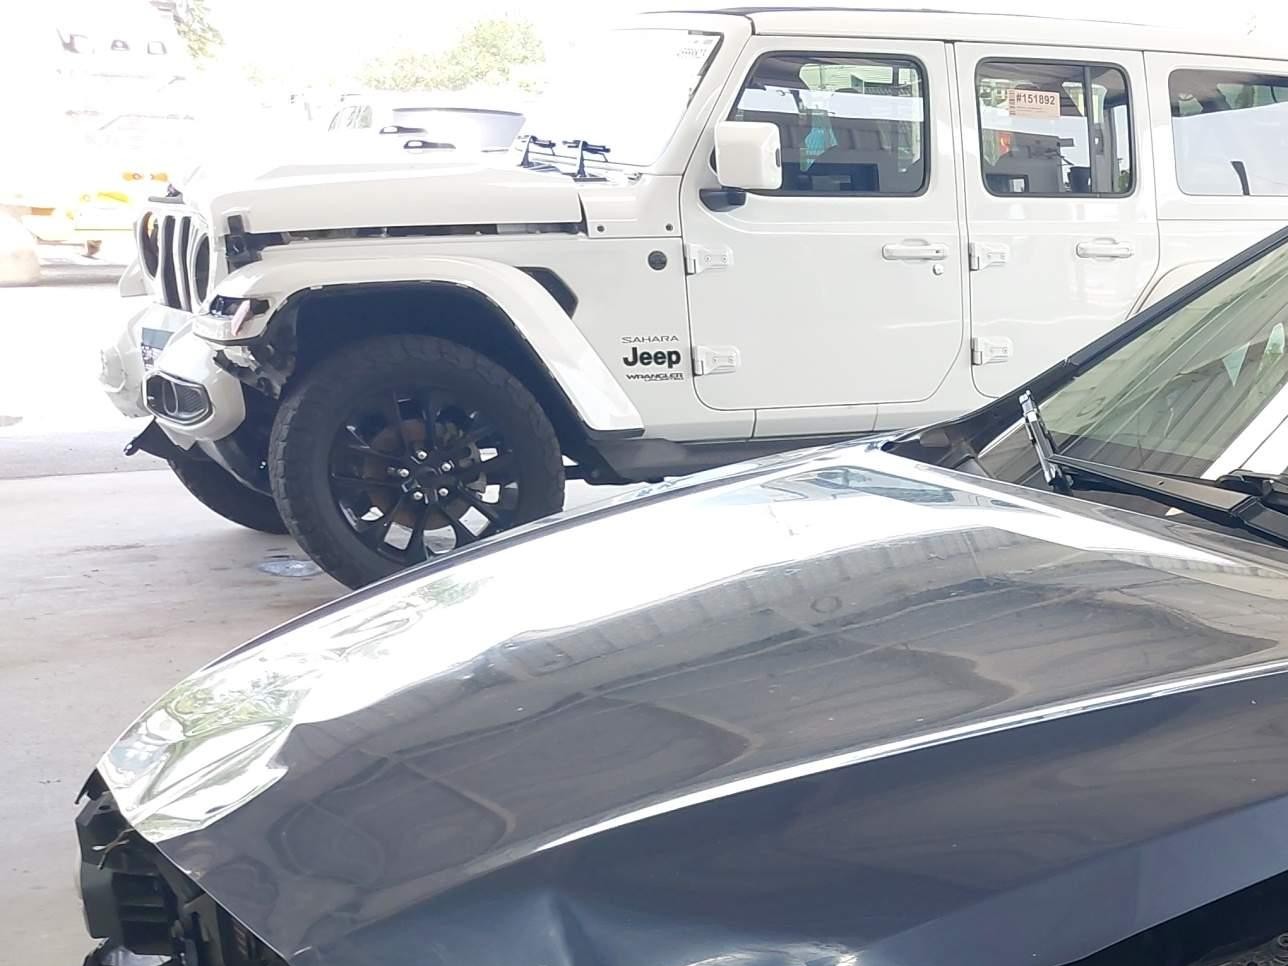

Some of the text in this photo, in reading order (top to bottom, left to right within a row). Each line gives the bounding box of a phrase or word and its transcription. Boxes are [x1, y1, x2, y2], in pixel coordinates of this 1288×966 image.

[1016, 92, 1055, 105] #151892
[621, 335, 679, 343] SAHARA
[623, 346, 681, 369] Jeep
[626, 372, 684, 380] WRANGLER
